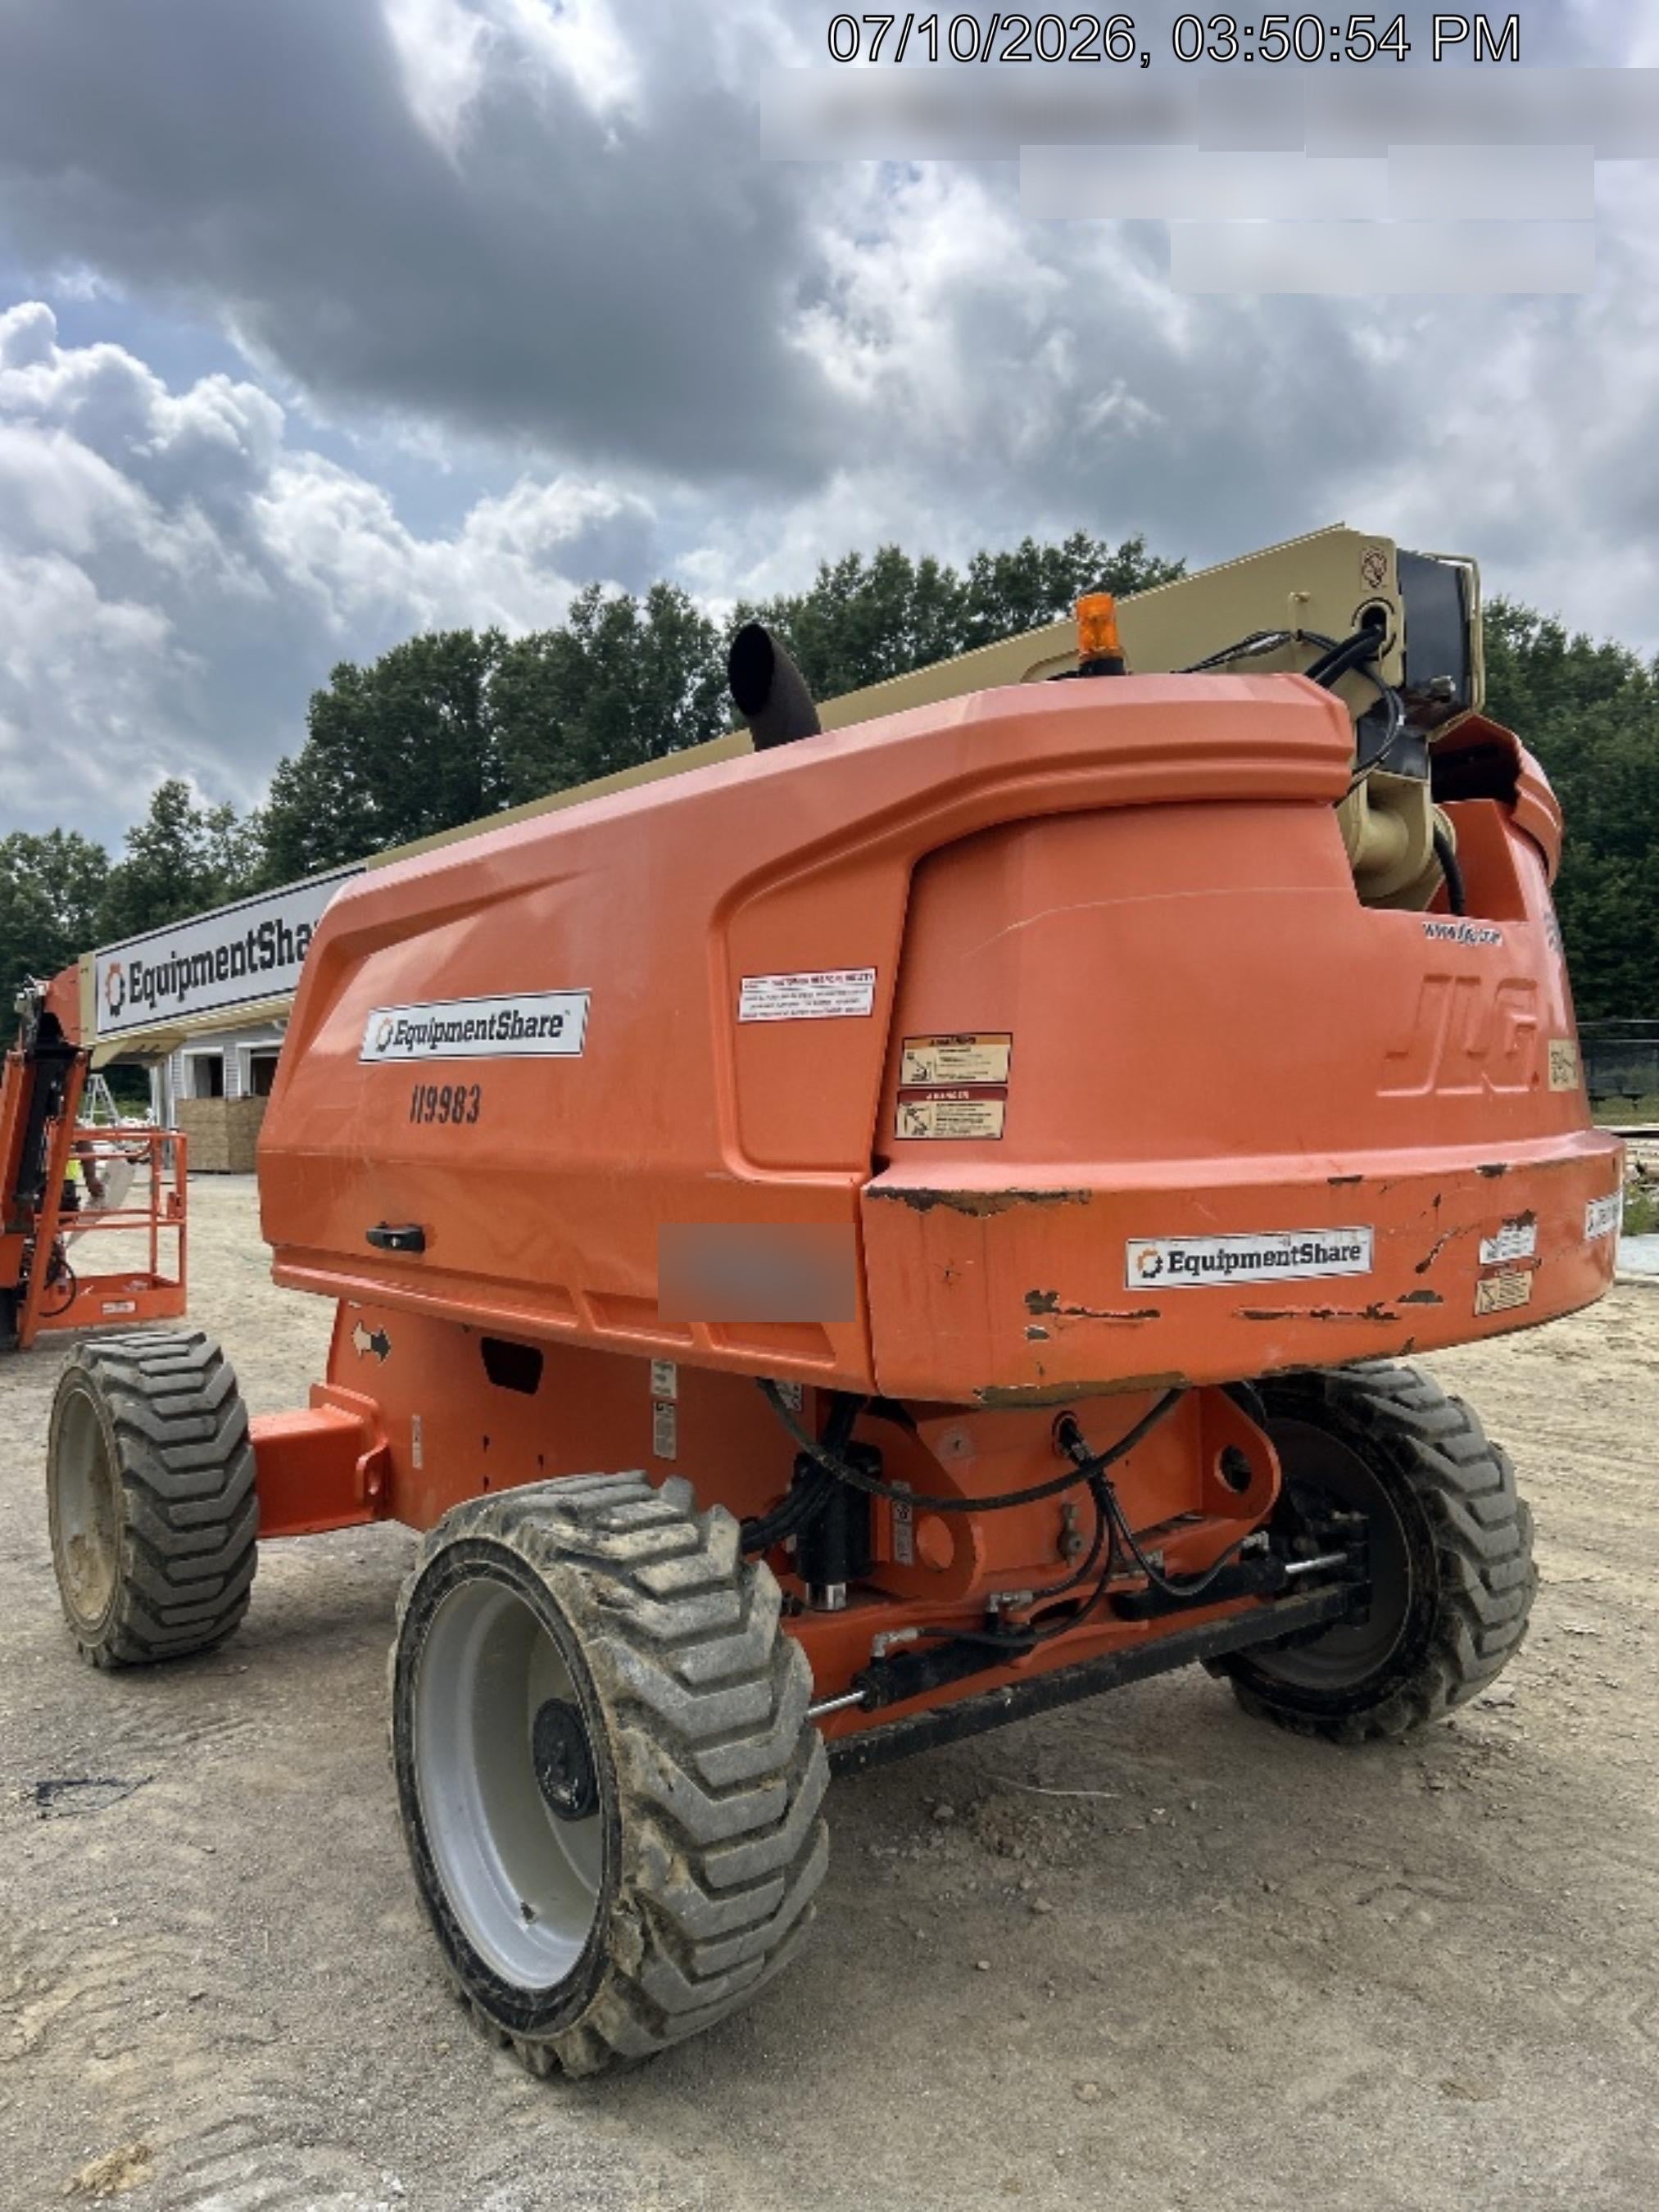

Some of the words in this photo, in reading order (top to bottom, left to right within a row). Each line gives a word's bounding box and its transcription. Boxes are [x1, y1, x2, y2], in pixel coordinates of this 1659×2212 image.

[129, 918, 318, 1009] EquipmentSha
[392, 1009, 564, 1051] EquipmentShare
[410, 1083, 481, 1124] 119983
[1167, 1244, 1361, 1276] EquipmentShare
